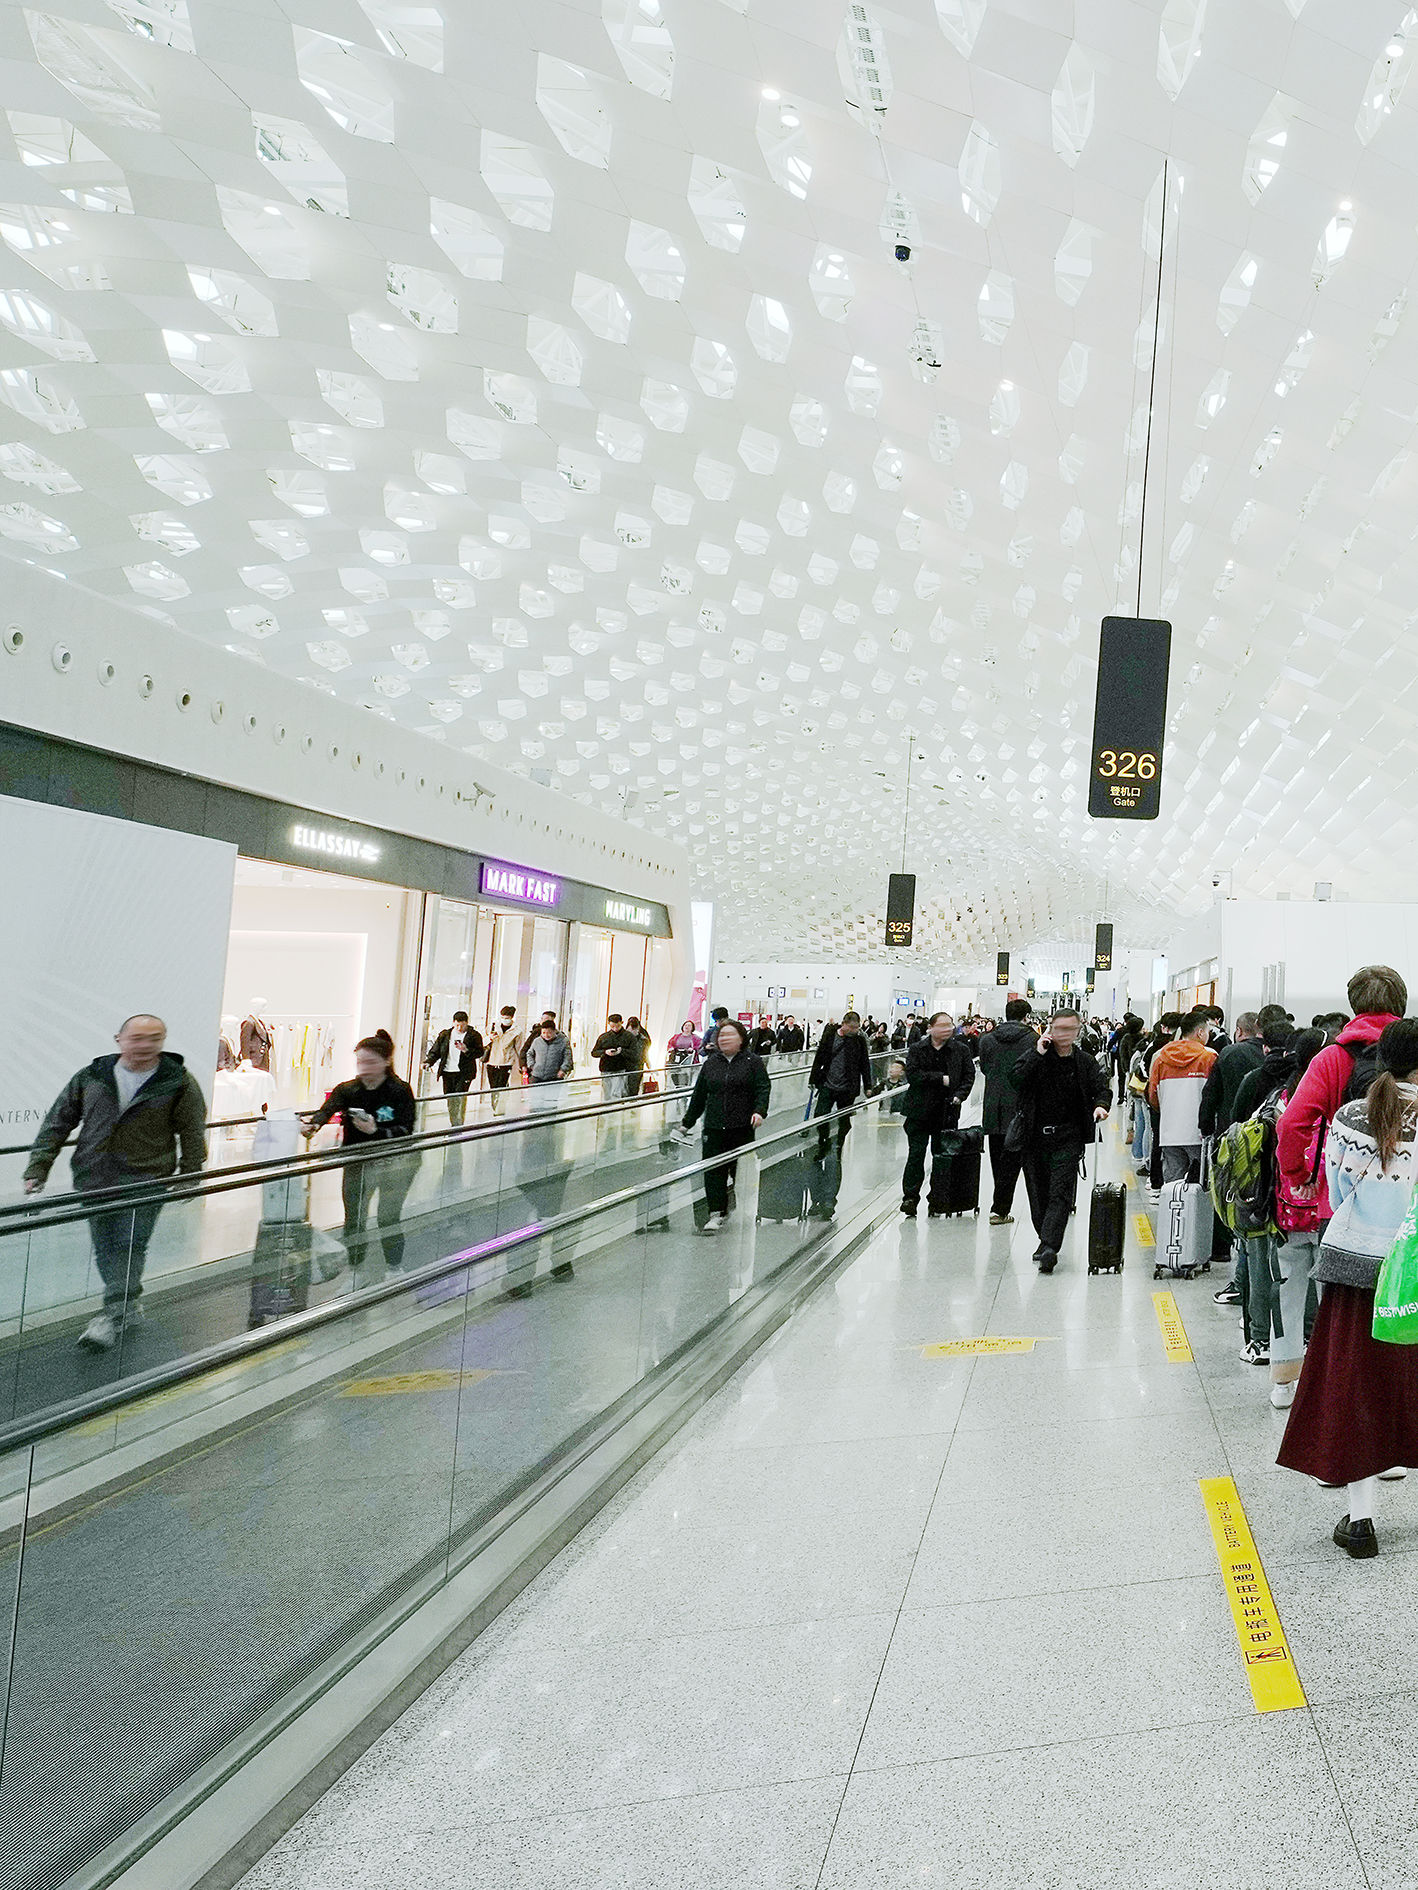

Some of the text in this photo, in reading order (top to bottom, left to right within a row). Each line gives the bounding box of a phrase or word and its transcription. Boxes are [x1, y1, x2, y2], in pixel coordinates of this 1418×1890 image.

[1099, 750, 1156, 780] 326
[1110, 786, 1141, 797] 登机口
[1113, 797, 1136, 807] Gate
[294, 826, 360, 859] ELLASSAY
[486, 868, 557, 902] MARK FAST
[605, 900, 651, 925] MARYLING
[888, 921, 911, 933] 325
[1378, 1306, 1397, 1318] BEST
[1231, 1562, 1272, 1643] 电瓶车专用通道
